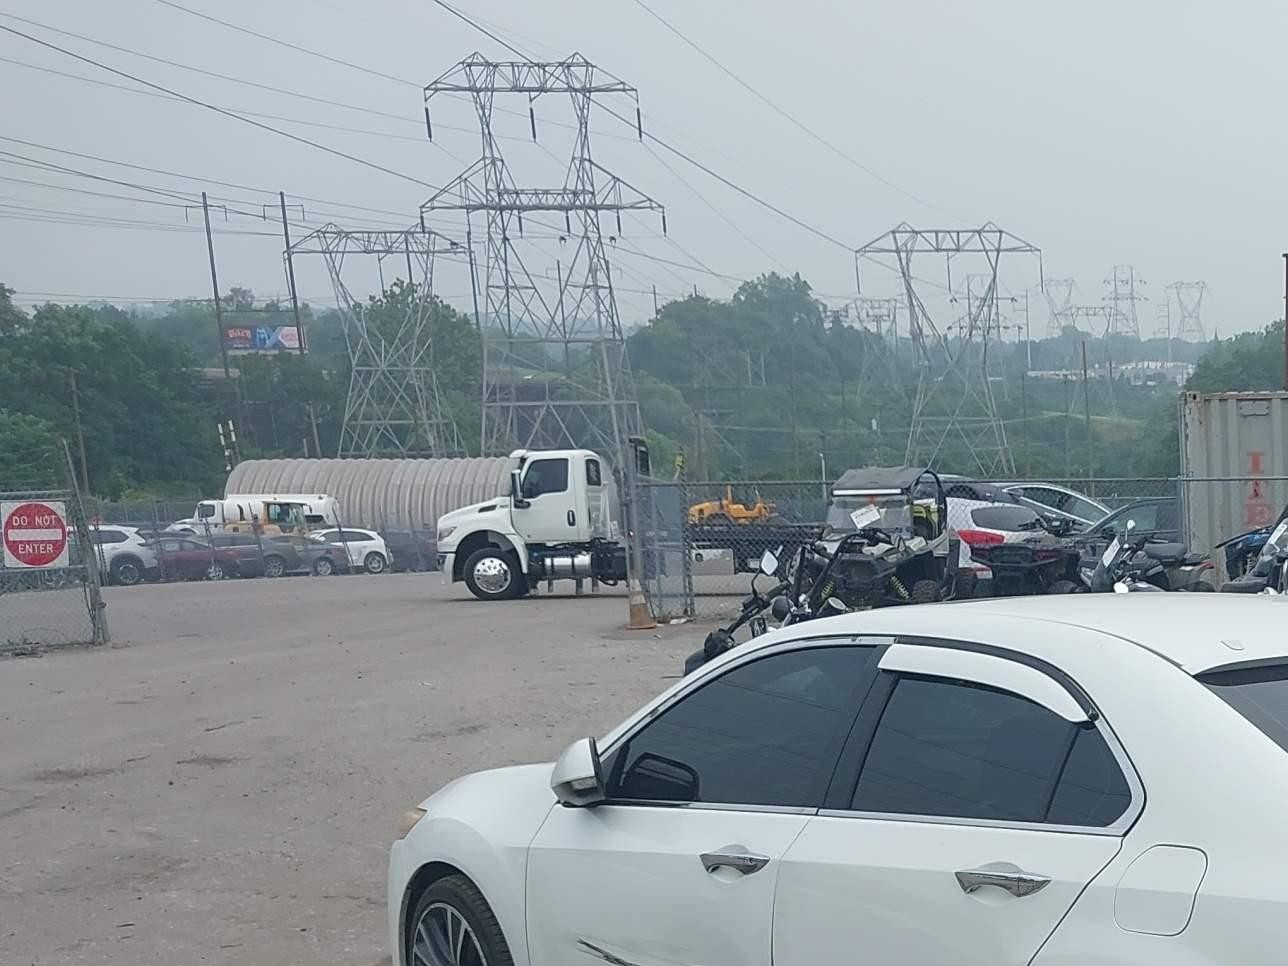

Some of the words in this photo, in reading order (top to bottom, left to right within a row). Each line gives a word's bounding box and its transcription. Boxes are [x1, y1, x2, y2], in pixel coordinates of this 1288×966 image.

[12, 515, 28, 526] DO
[34, 515, 57, 526] NOT
[18, 543, 54, 554] ENTER
